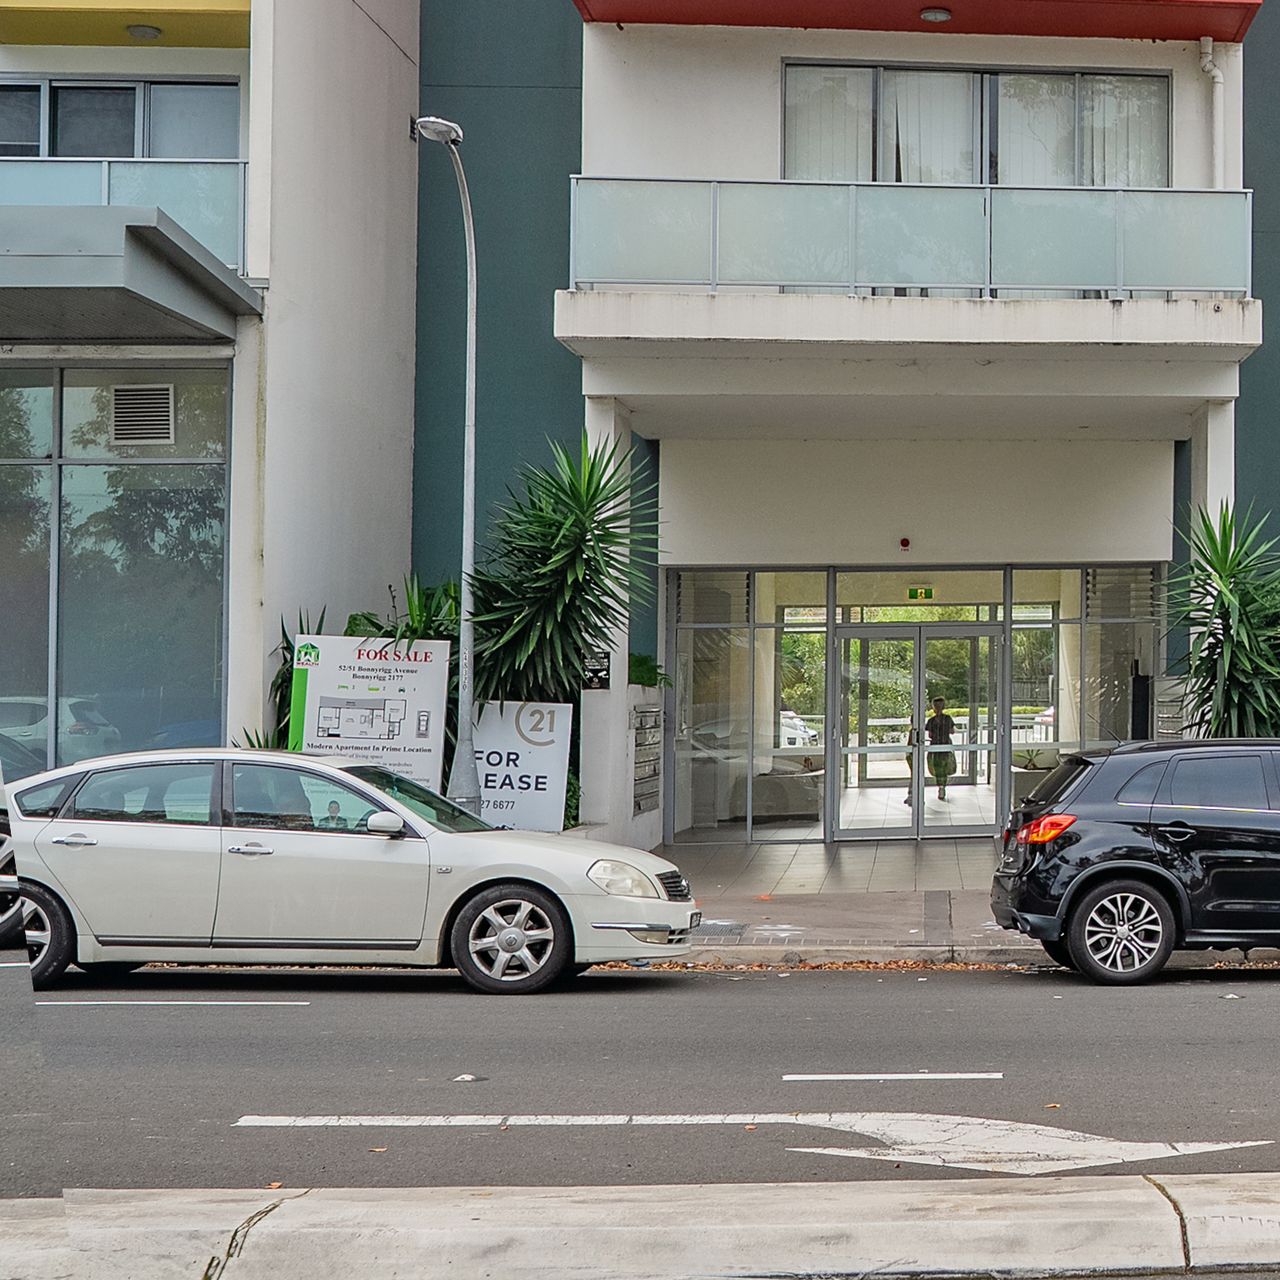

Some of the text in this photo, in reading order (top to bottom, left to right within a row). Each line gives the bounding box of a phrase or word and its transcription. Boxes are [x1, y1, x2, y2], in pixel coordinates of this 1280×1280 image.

[356, 649, 433, 663] FOR SALE
[358, 666, 392, 674] Bonnyrigg
[352, 673, 386, 681] Bonnyrigg
[306, 742, 333, 750] Modern
[335, 744, 371, 752] Apartment
[480, 773, 548, 792] EASE
[493, 800, 515, 810] 6677
